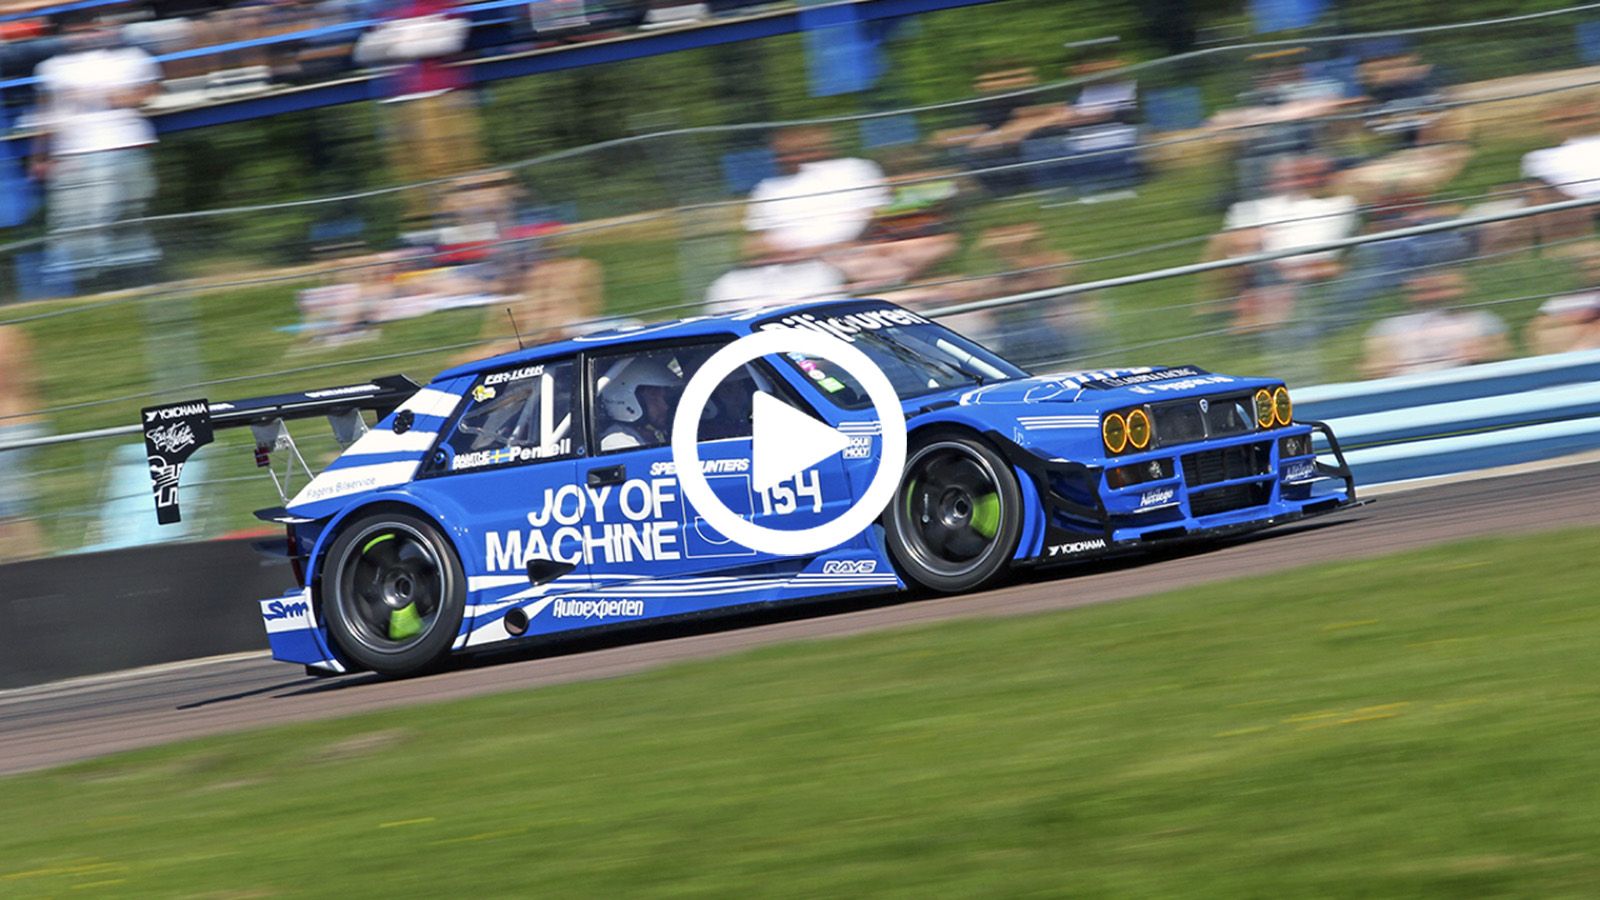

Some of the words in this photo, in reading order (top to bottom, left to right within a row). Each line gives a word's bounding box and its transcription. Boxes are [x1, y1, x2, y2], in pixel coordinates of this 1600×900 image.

[158, 403, 207, 419] YOKOHAMA
[509, 438, 571, 462] Penell
[527, 483, 612, 527] JOY
[619, 478, 677, 521] OF
[485, 521, 681, 572] MACHINE
[1060, 539, 1106, 554] YOKOHAMA
[823, 560, 877, 574] RAYS
[553, 598, 644, 620] Autoexperten
